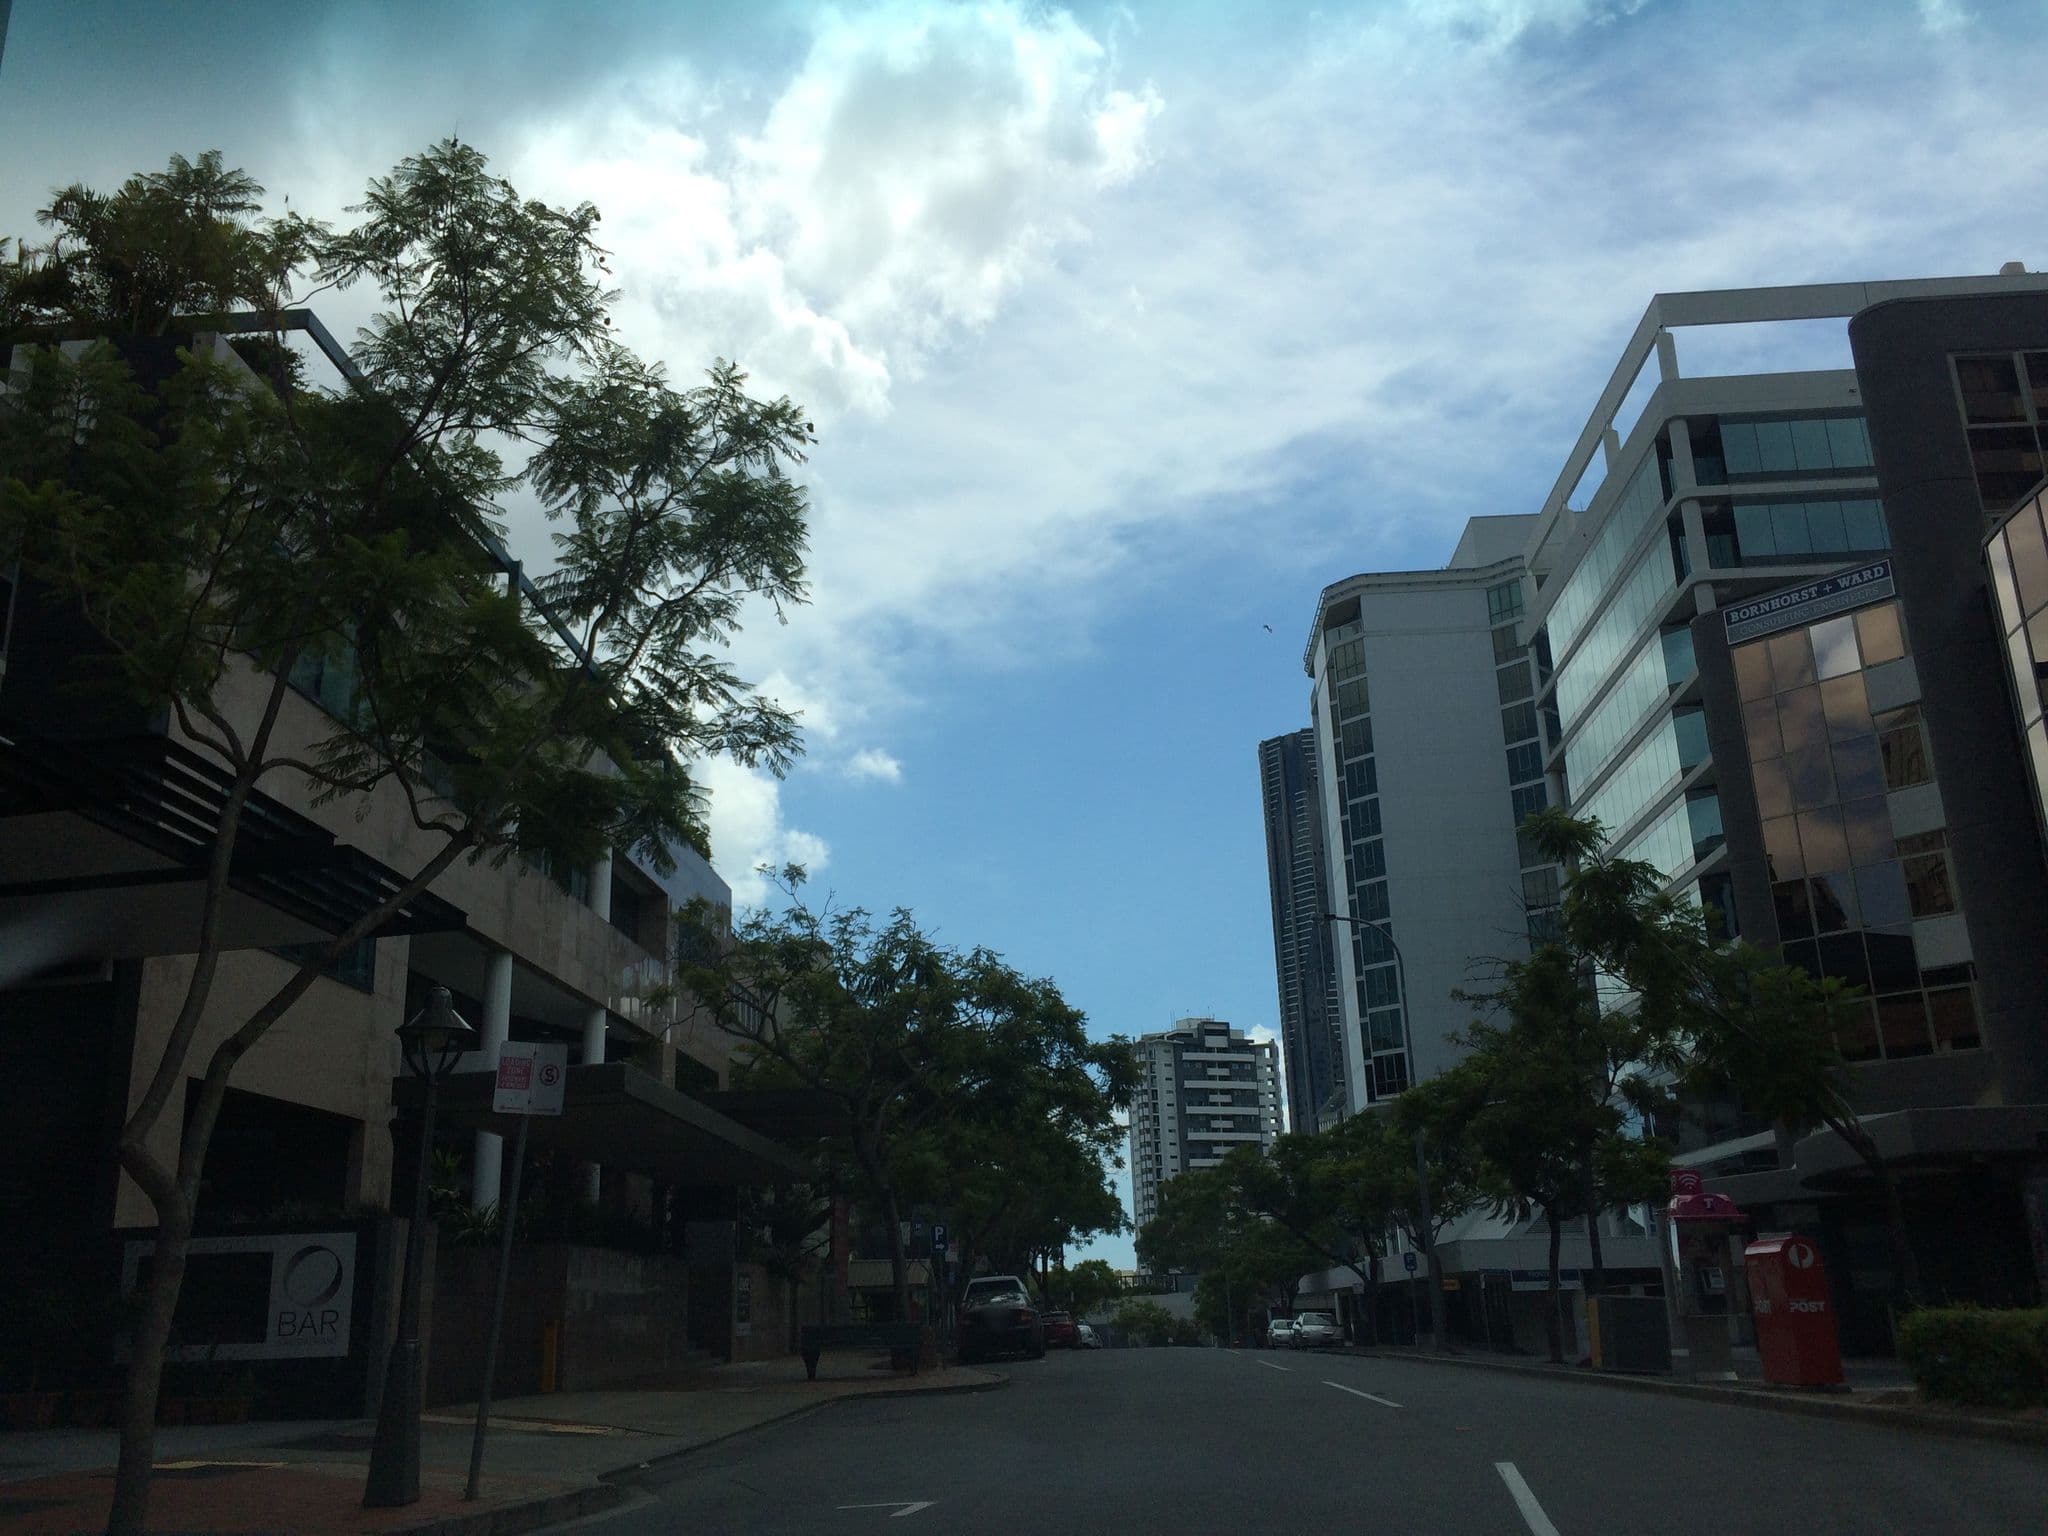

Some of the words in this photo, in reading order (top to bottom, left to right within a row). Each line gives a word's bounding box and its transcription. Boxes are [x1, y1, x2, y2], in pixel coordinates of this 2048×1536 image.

[1729, 586, 1818, 623] BORNHORST
[1836, 566, 1885, 590] WARD
[1739, 607, 1810, 634] CONSULTING
[1812, 586, 1880, 613] ENGINEERS
[935, 1226, 944, 1241] P
[1789, 1301, 1825, 1313] POST
[278, 1310, 339, 1337] BAR
